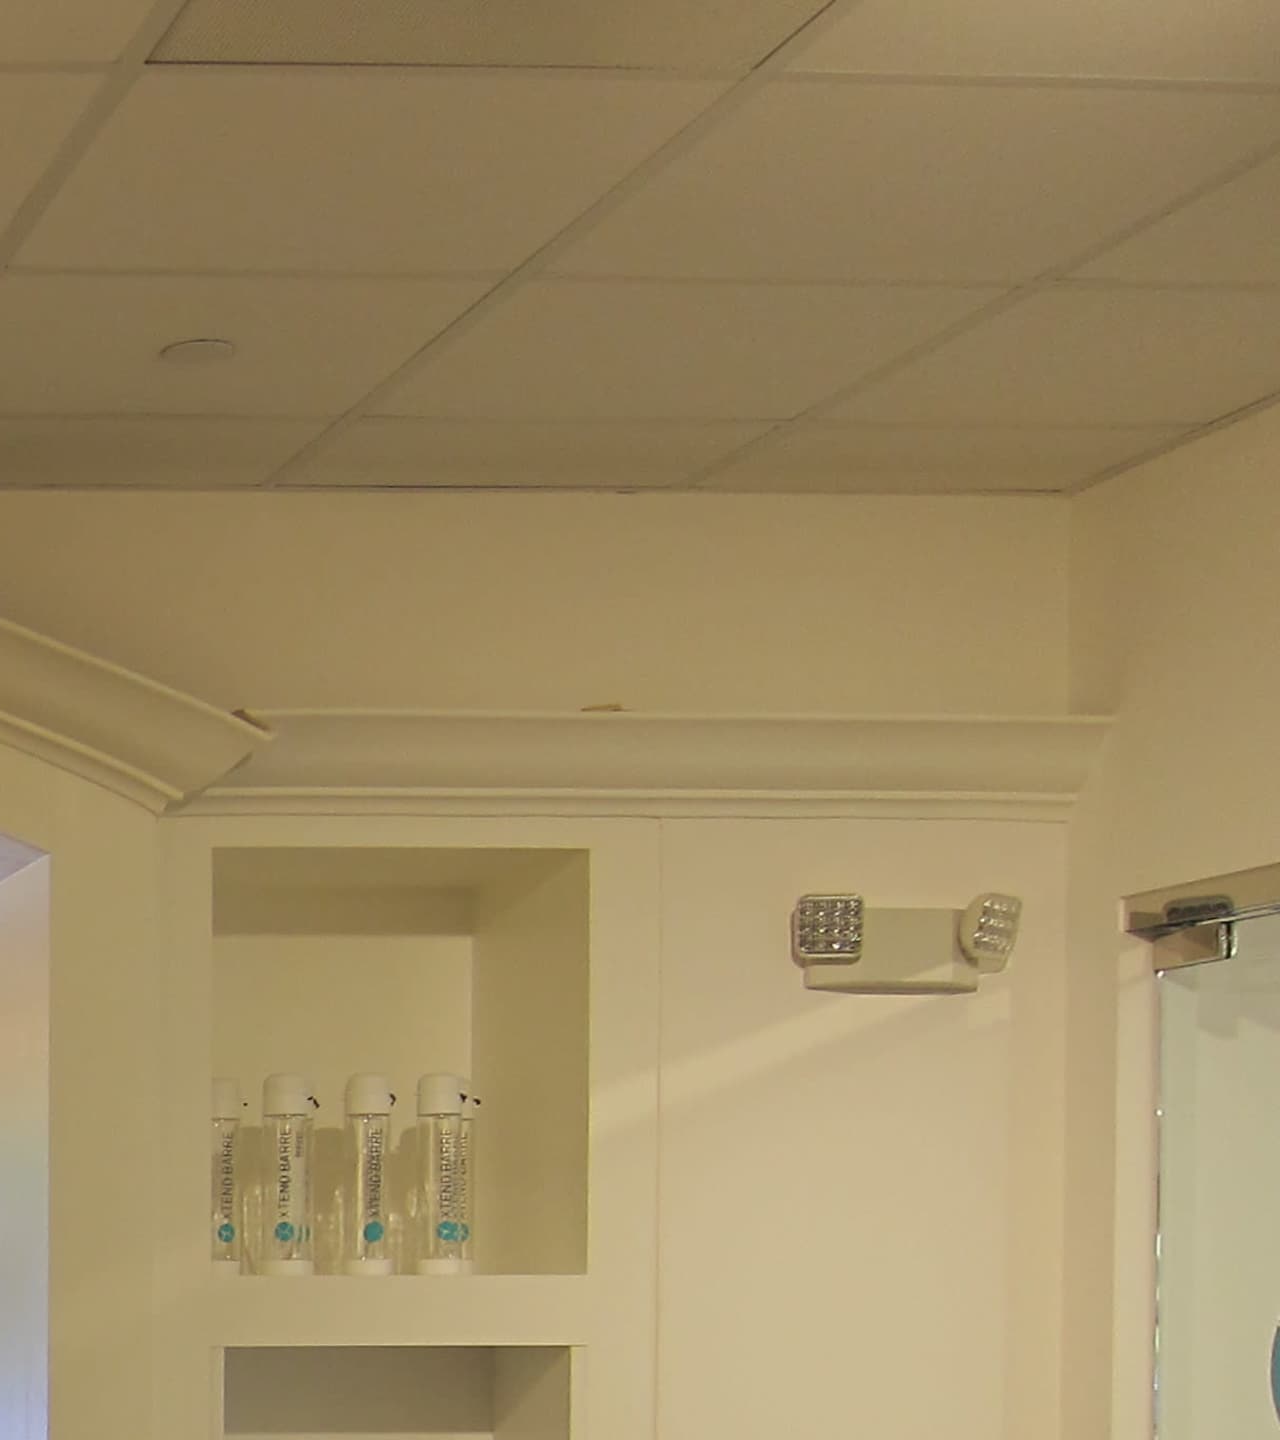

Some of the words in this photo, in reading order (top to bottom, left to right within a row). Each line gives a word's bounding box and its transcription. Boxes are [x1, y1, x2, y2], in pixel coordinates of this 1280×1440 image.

[279, 1127, 291, 1172] BARRE
[440, 1127, 452, 1172] BARRE
[277, 1175, 291, 1218] XTEND
[440, 1175, 452, 1218] XTEND
